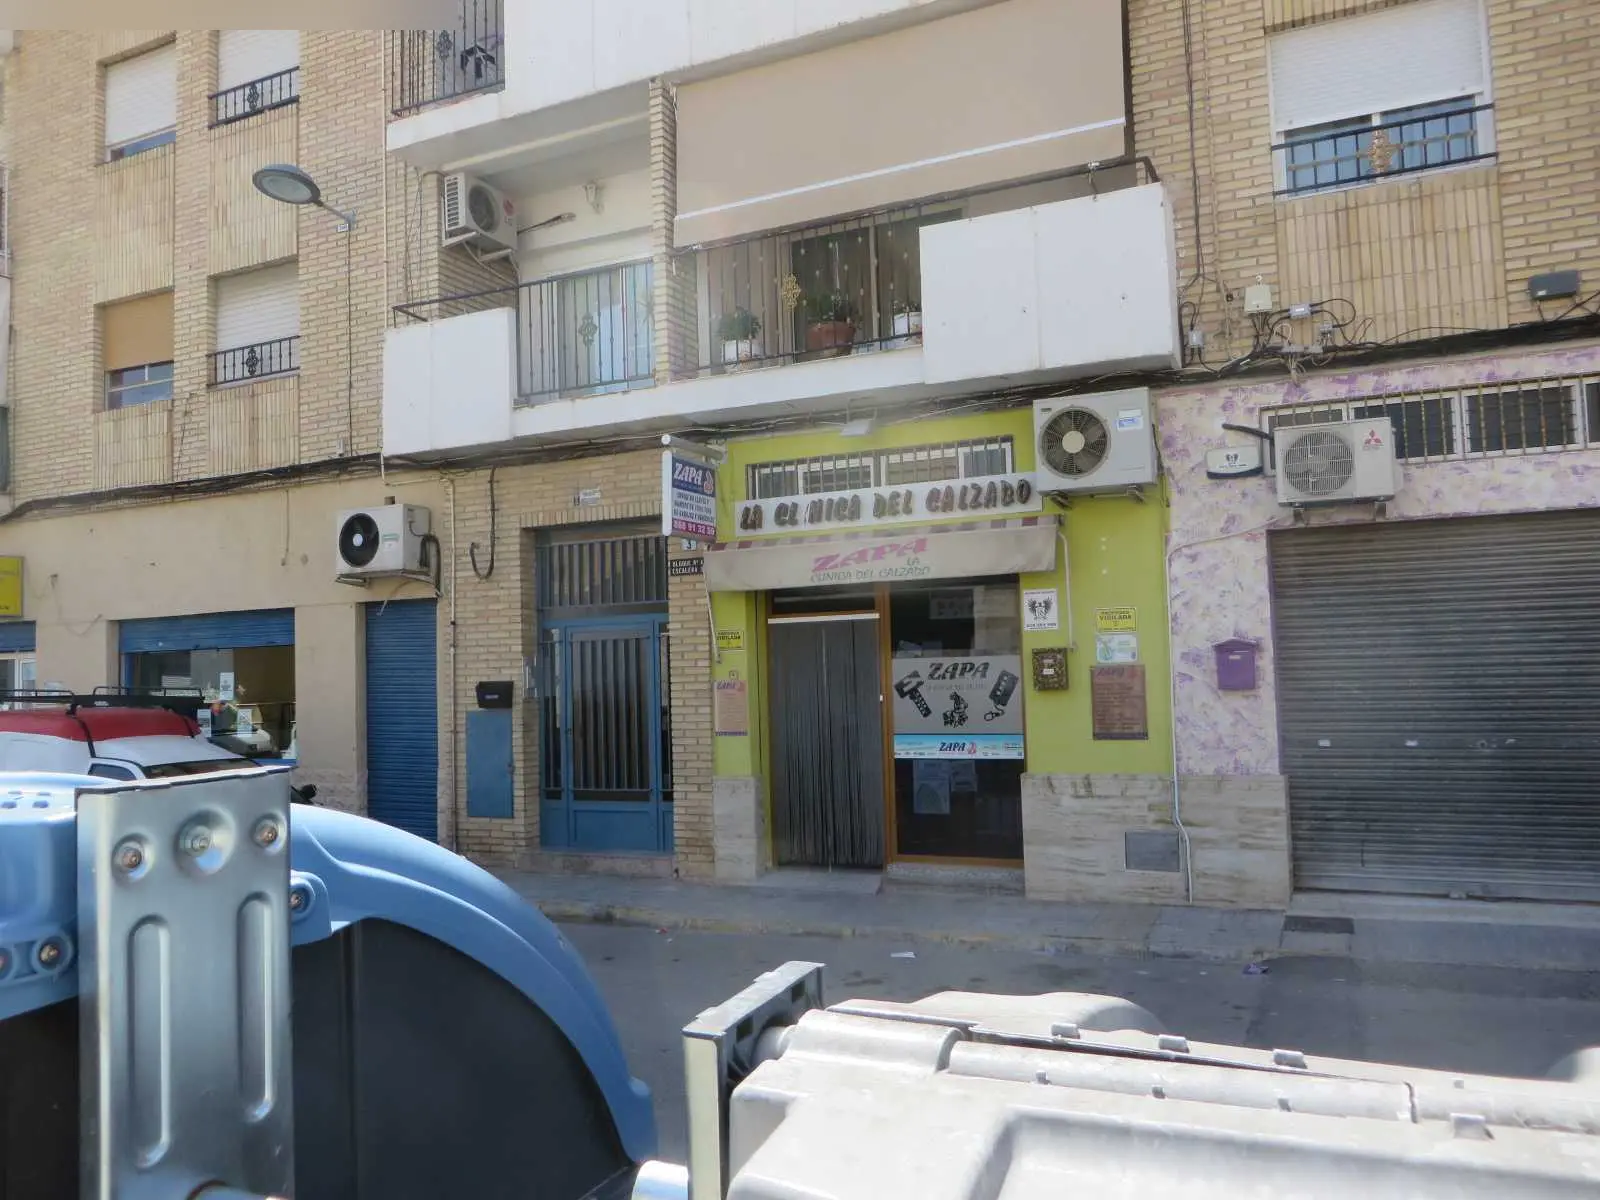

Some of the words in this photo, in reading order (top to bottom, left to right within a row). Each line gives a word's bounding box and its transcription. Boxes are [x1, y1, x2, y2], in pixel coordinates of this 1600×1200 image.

[674, 463, 703, 485] ZAPA
[740, 504, 764, 531] LA
[872, 489, 913, 519] DEL
[925, 478, 1032, 513] CALZADO
[812, 537, 928, 572] ZAPA
[927, 661, 990, 680] ZAPA
[939, 741, 967, 752] ZAPA
